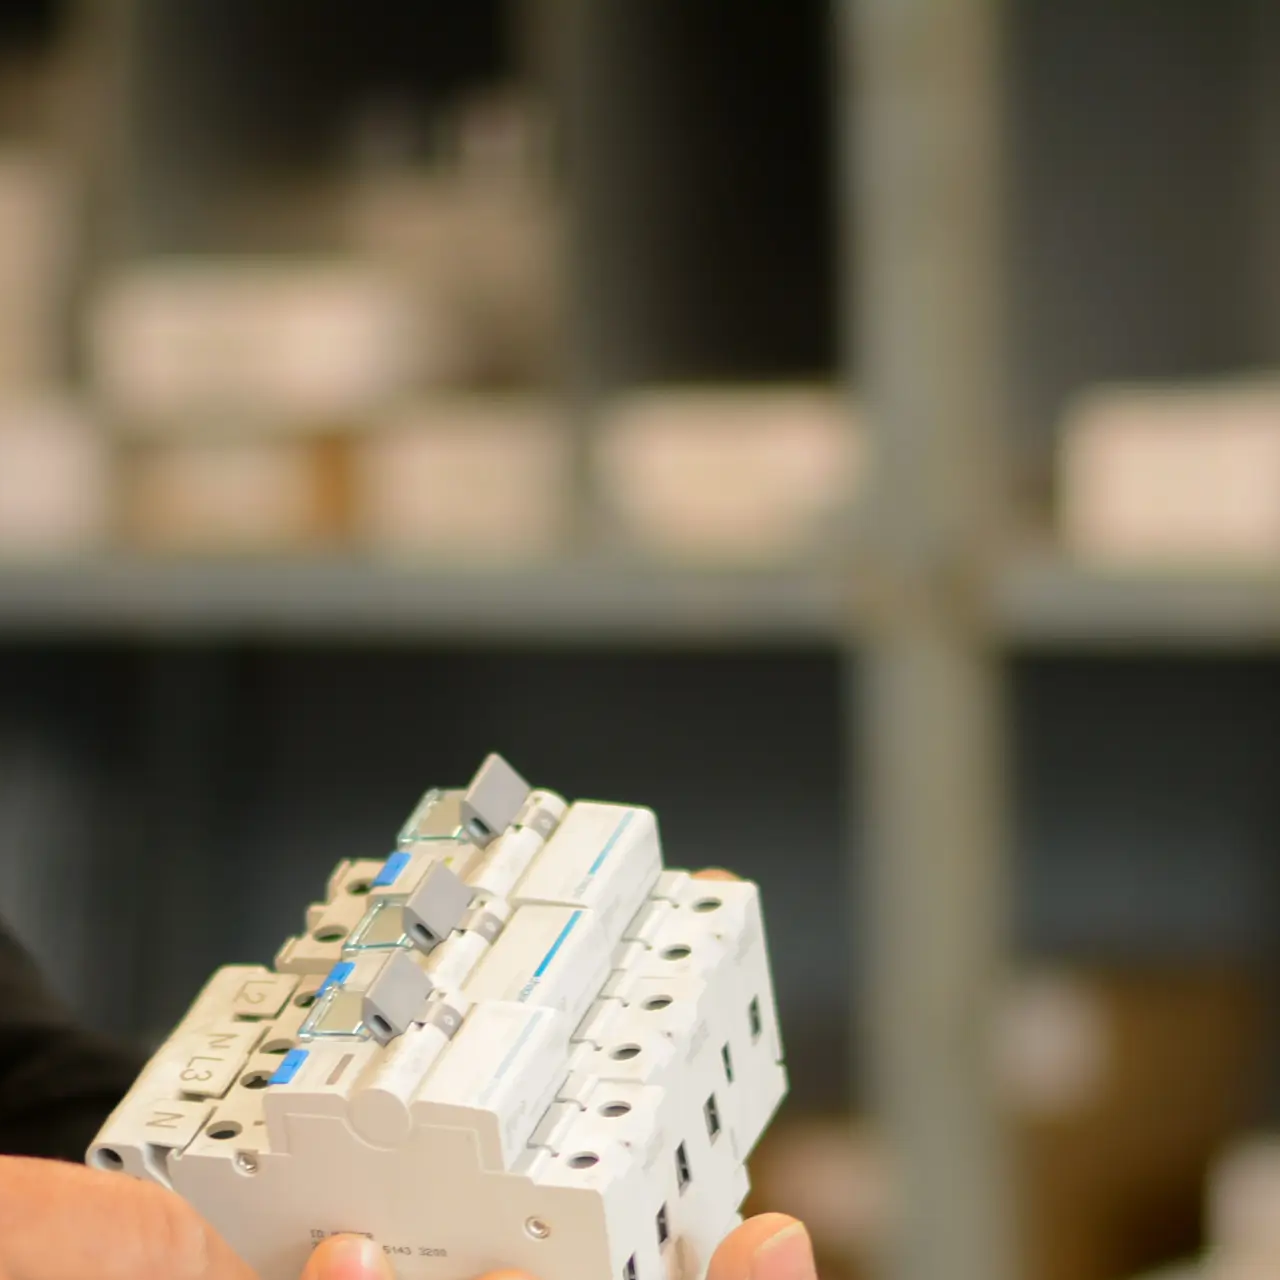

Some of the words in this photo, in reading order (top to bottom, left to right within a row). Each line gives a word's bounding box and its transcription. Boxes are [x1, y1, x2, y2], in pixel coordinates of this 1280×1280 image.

[233, 979, 277, 1004] L2
[207, 1032, 238, 1050] N
[180, 1056, 224, 1082] L3
[145, 1111, 185, 1129] N
